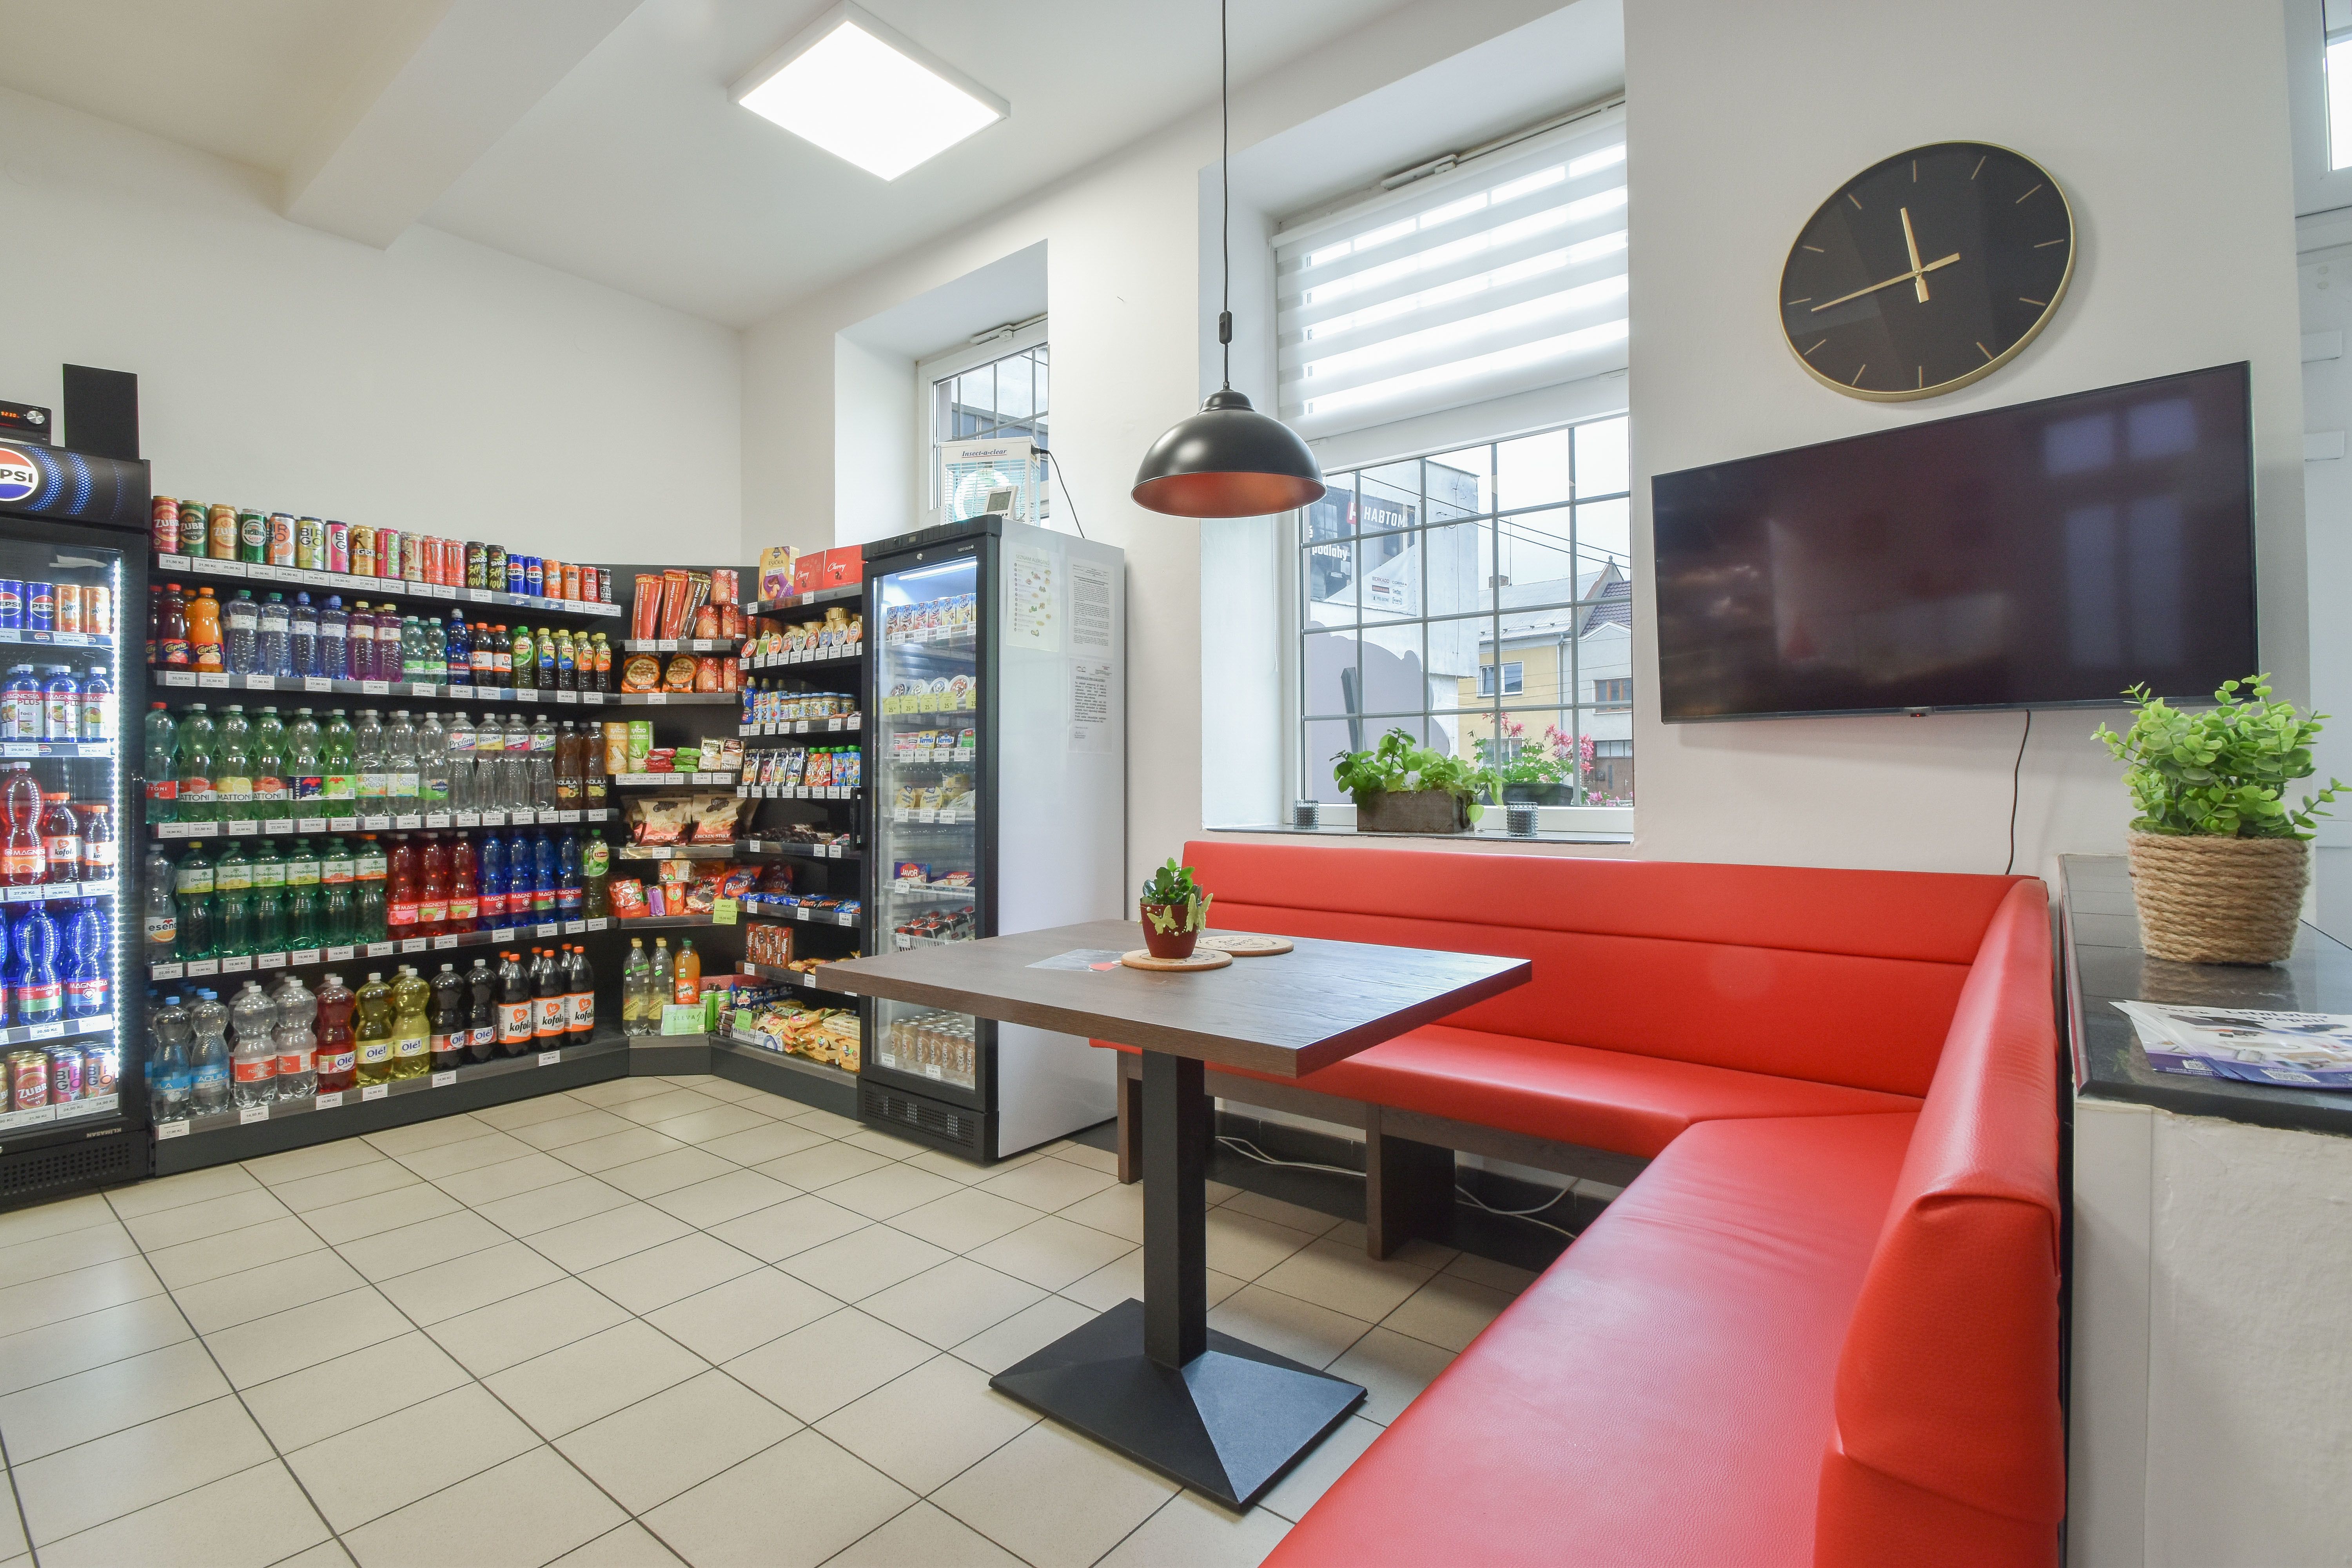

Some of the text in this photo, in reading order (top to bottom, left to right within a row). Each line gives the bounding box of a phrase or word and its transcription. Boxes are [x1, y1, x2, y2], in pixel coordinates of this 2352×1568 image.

[0, 469, 33, 483] PSI
[1364, 506, 1406, 527] HABTOM
[154, 519, 179, 528] ZUBR
[180, 522, 205, 531] ZUBR
[827, 562, 846, 572] Cherry
[796, 571, 809, 580] Cherry
[165, 642, 189, 653] Caprio
[197, 643, 219, 655] Caprio
[901, 868, 918, 877] JAVOR
[542, 1013, 564, 1027] kofola
[509, 1019, 531, 1033] kofola
[475, 1029, 492, 1040] Olé!
[402, 1040, 421, 1051] Olé!
[367, 1046, 386, 1058] Olé!
[18, 1083, 47, 1099] ZUBR
